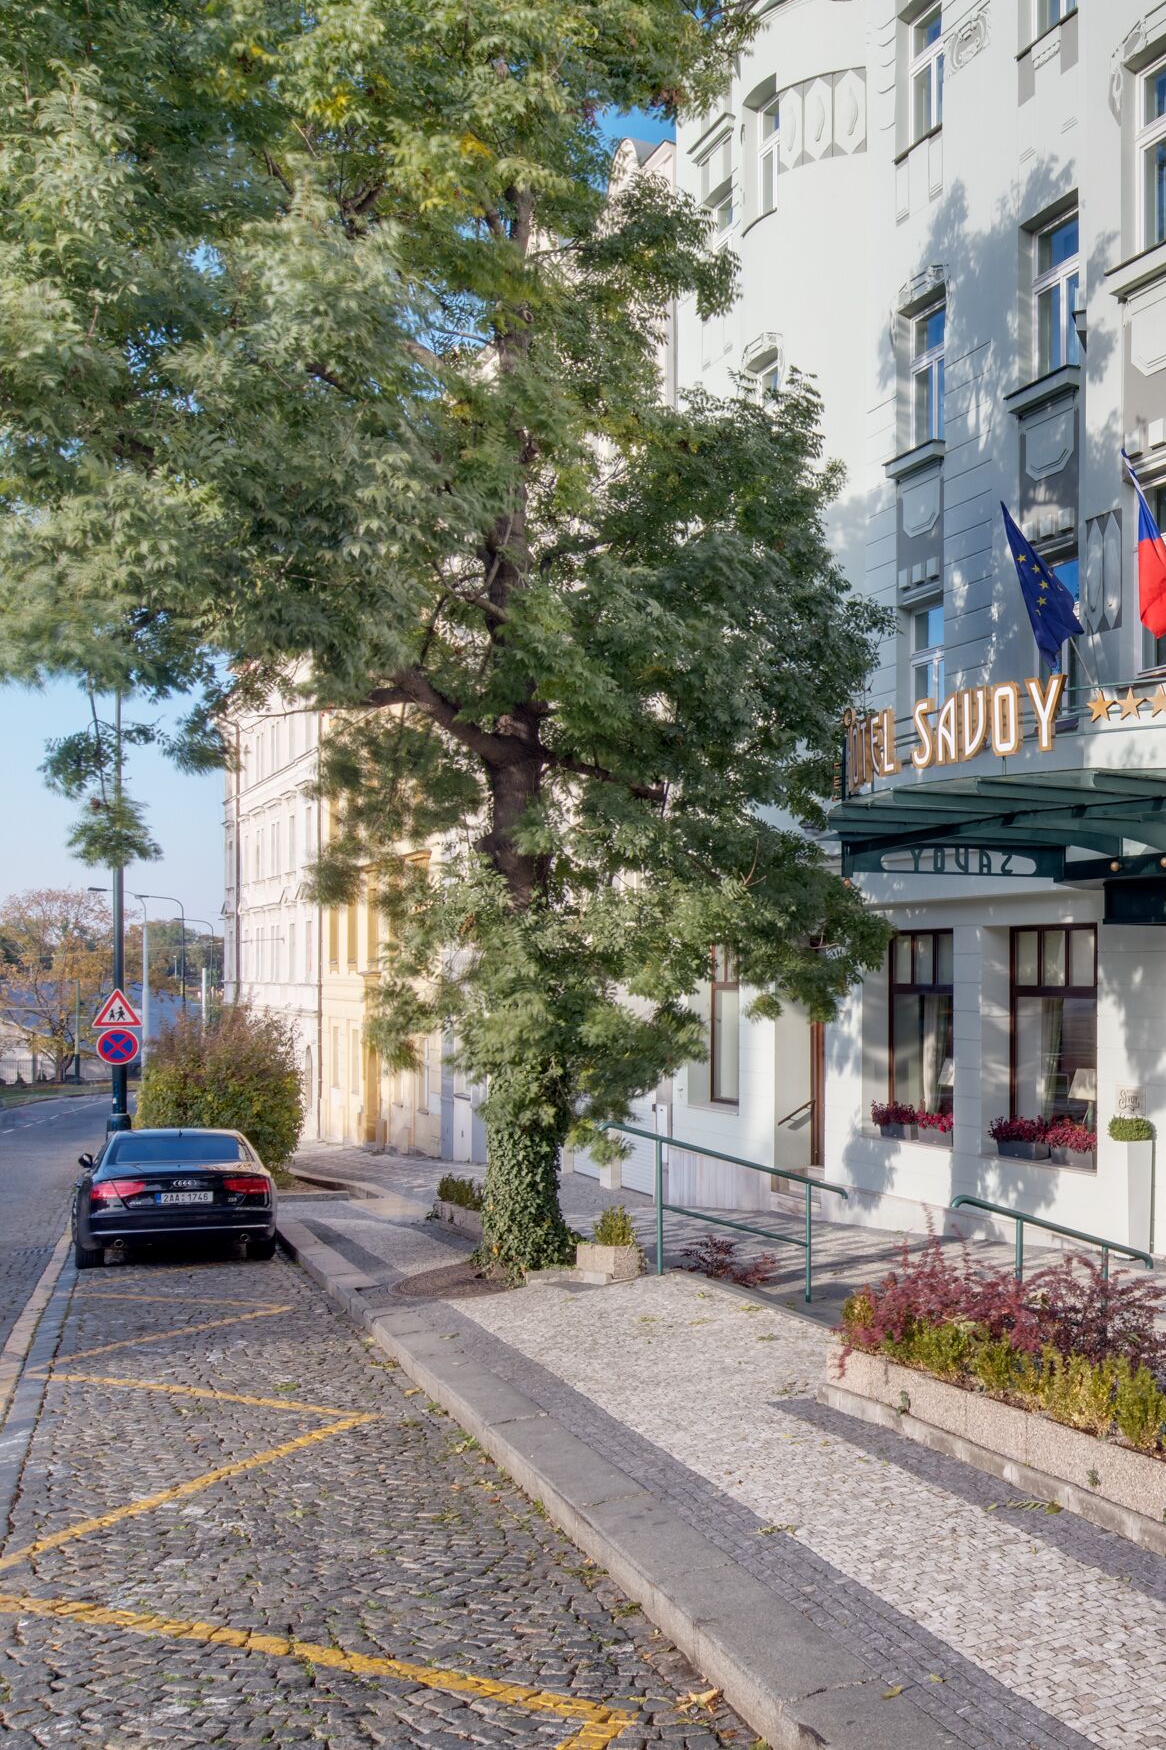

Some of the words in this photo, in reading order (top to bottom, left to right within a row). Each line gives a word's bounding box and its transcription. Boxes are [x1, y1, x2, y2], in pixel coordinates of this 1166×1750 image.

[846, 706, 902, 792] OTEL
[911, 674, 1067, 769] SAVOY
[163, 1194, 180, 1203] 2AA
[188, 1193, 208, 1201] 1746
